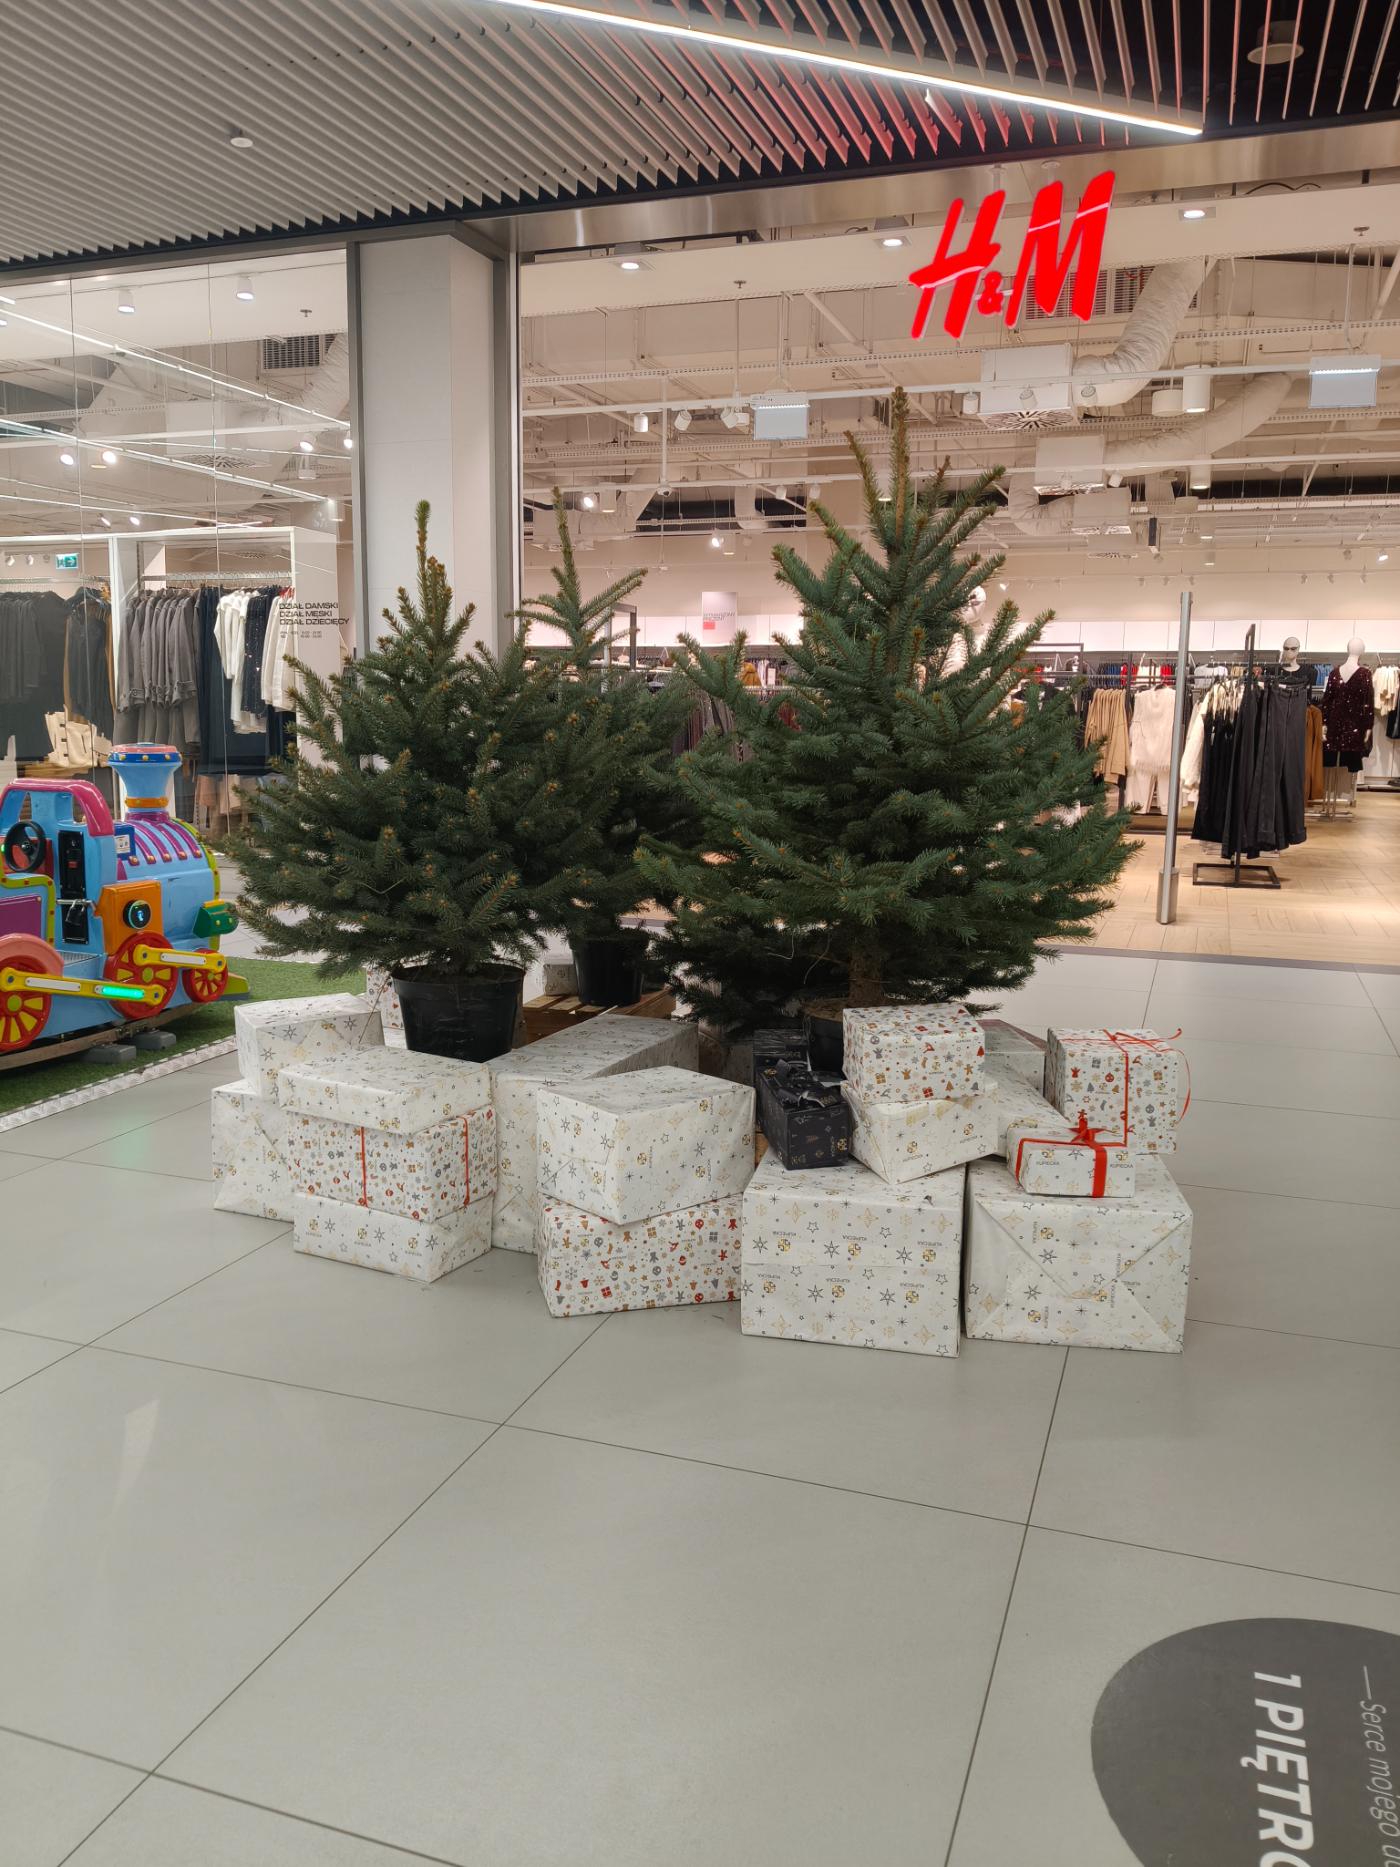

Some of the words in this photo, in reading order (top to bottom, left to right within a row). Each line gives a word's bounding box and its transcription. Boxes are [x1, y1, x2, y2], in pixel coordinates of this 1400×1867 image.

[908, 169, 1116, 340] H&M
[279, 602, 304, 610] DZIAŁ
[305, 602, 339, 610] DAMSKI
[279, 610, 304, 618] DZIAŁ
[279, 618, 304, 626] DZIAŁ
[842, 1234, 868, 1242] KUPIECKA
[1254, 1671, 1302, 1688] 1
[1360, 1700, 1387, 1752] Serce
[1366, 1757, 1400, 1837] mojego
